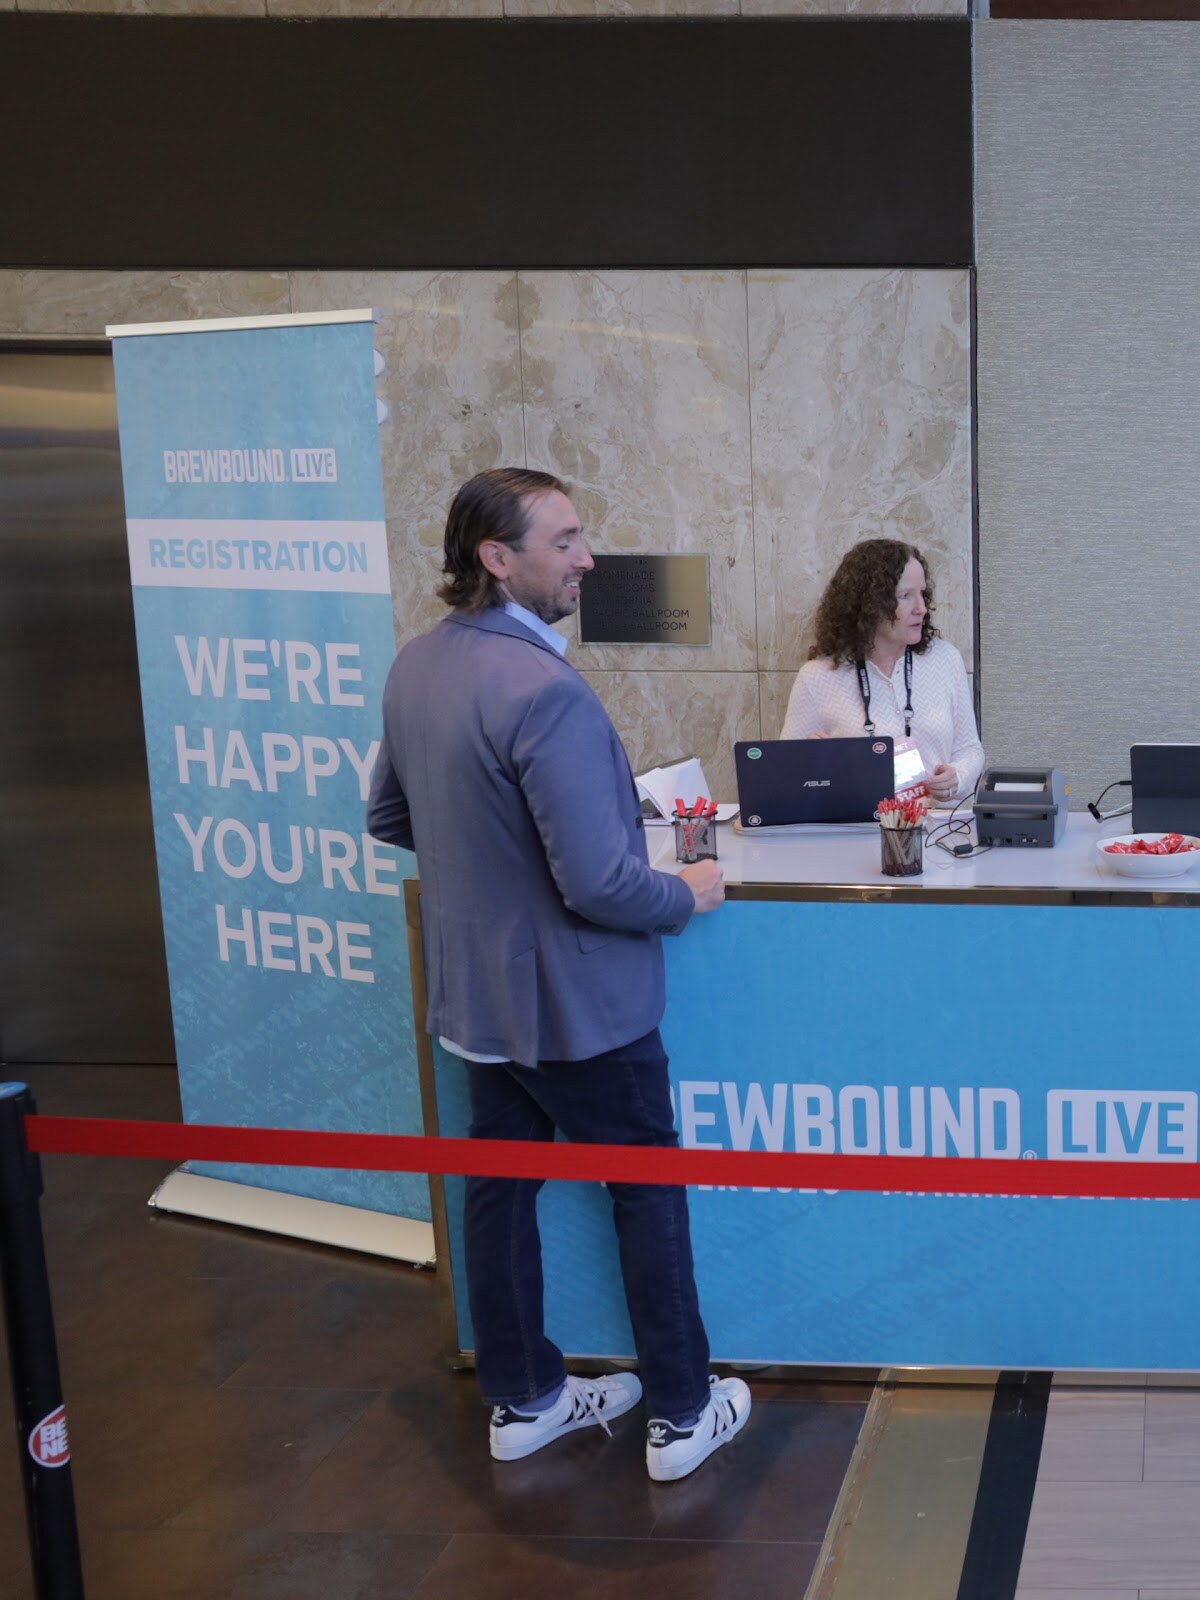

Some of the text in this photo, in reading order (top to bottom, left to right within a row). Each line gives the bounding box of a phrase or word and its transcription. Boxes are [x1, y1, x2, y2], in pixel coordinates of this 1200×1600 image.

[163, 449, 335, 483] BREWBOUND LIVE
[148, 538, 369, 574] REGISTRATION
[174, 635, 365, 707] WE'RE
[174, 725, 381, 801] HAPPY
[803, 779, 831, 788] ASUS
[896, 784, 926, 802] STAFF
[173, 812, 400, 897] YOU'RE
[215, 904, 375, 984] HERE
[672, 1080, 1187, 1160] EWBOUND LIVE
